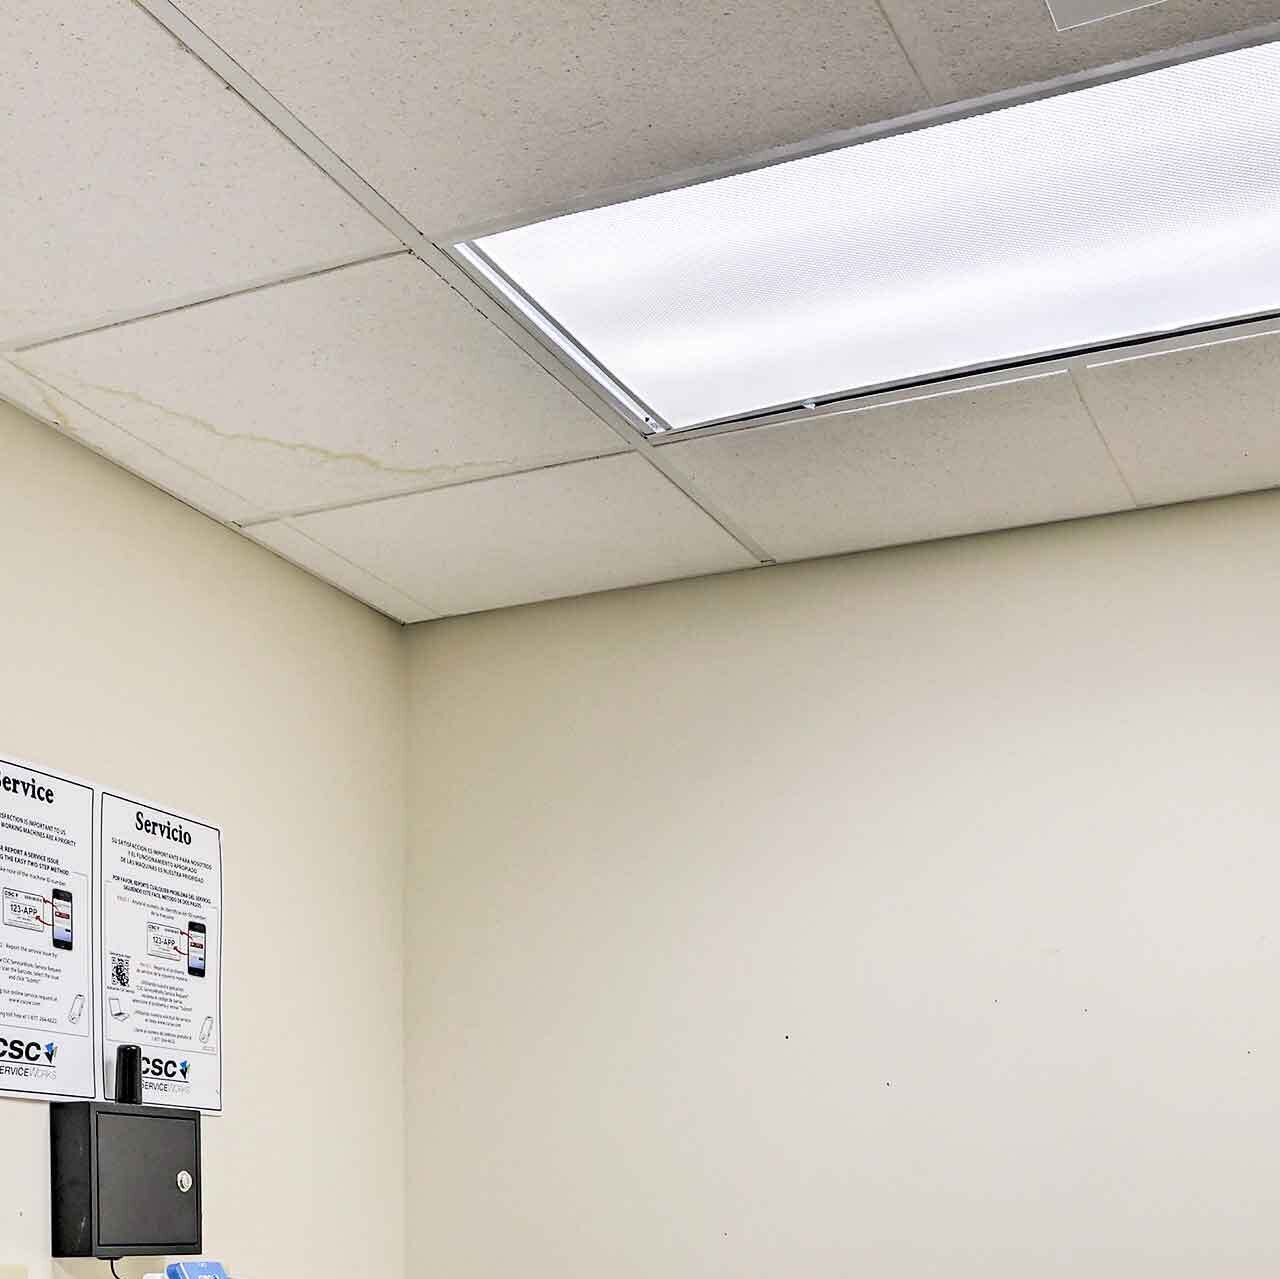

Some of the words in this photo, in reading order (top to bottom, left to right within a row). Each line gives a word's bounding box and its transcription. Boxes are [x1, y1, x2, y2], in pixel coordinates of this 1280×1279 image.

[136, 812, 191, 845] Servicio
[11, 903, 37, 915] 123-APP
[153, 936, 175, 947] 123-APP
[141, 1057, 176, 1077] CSC
